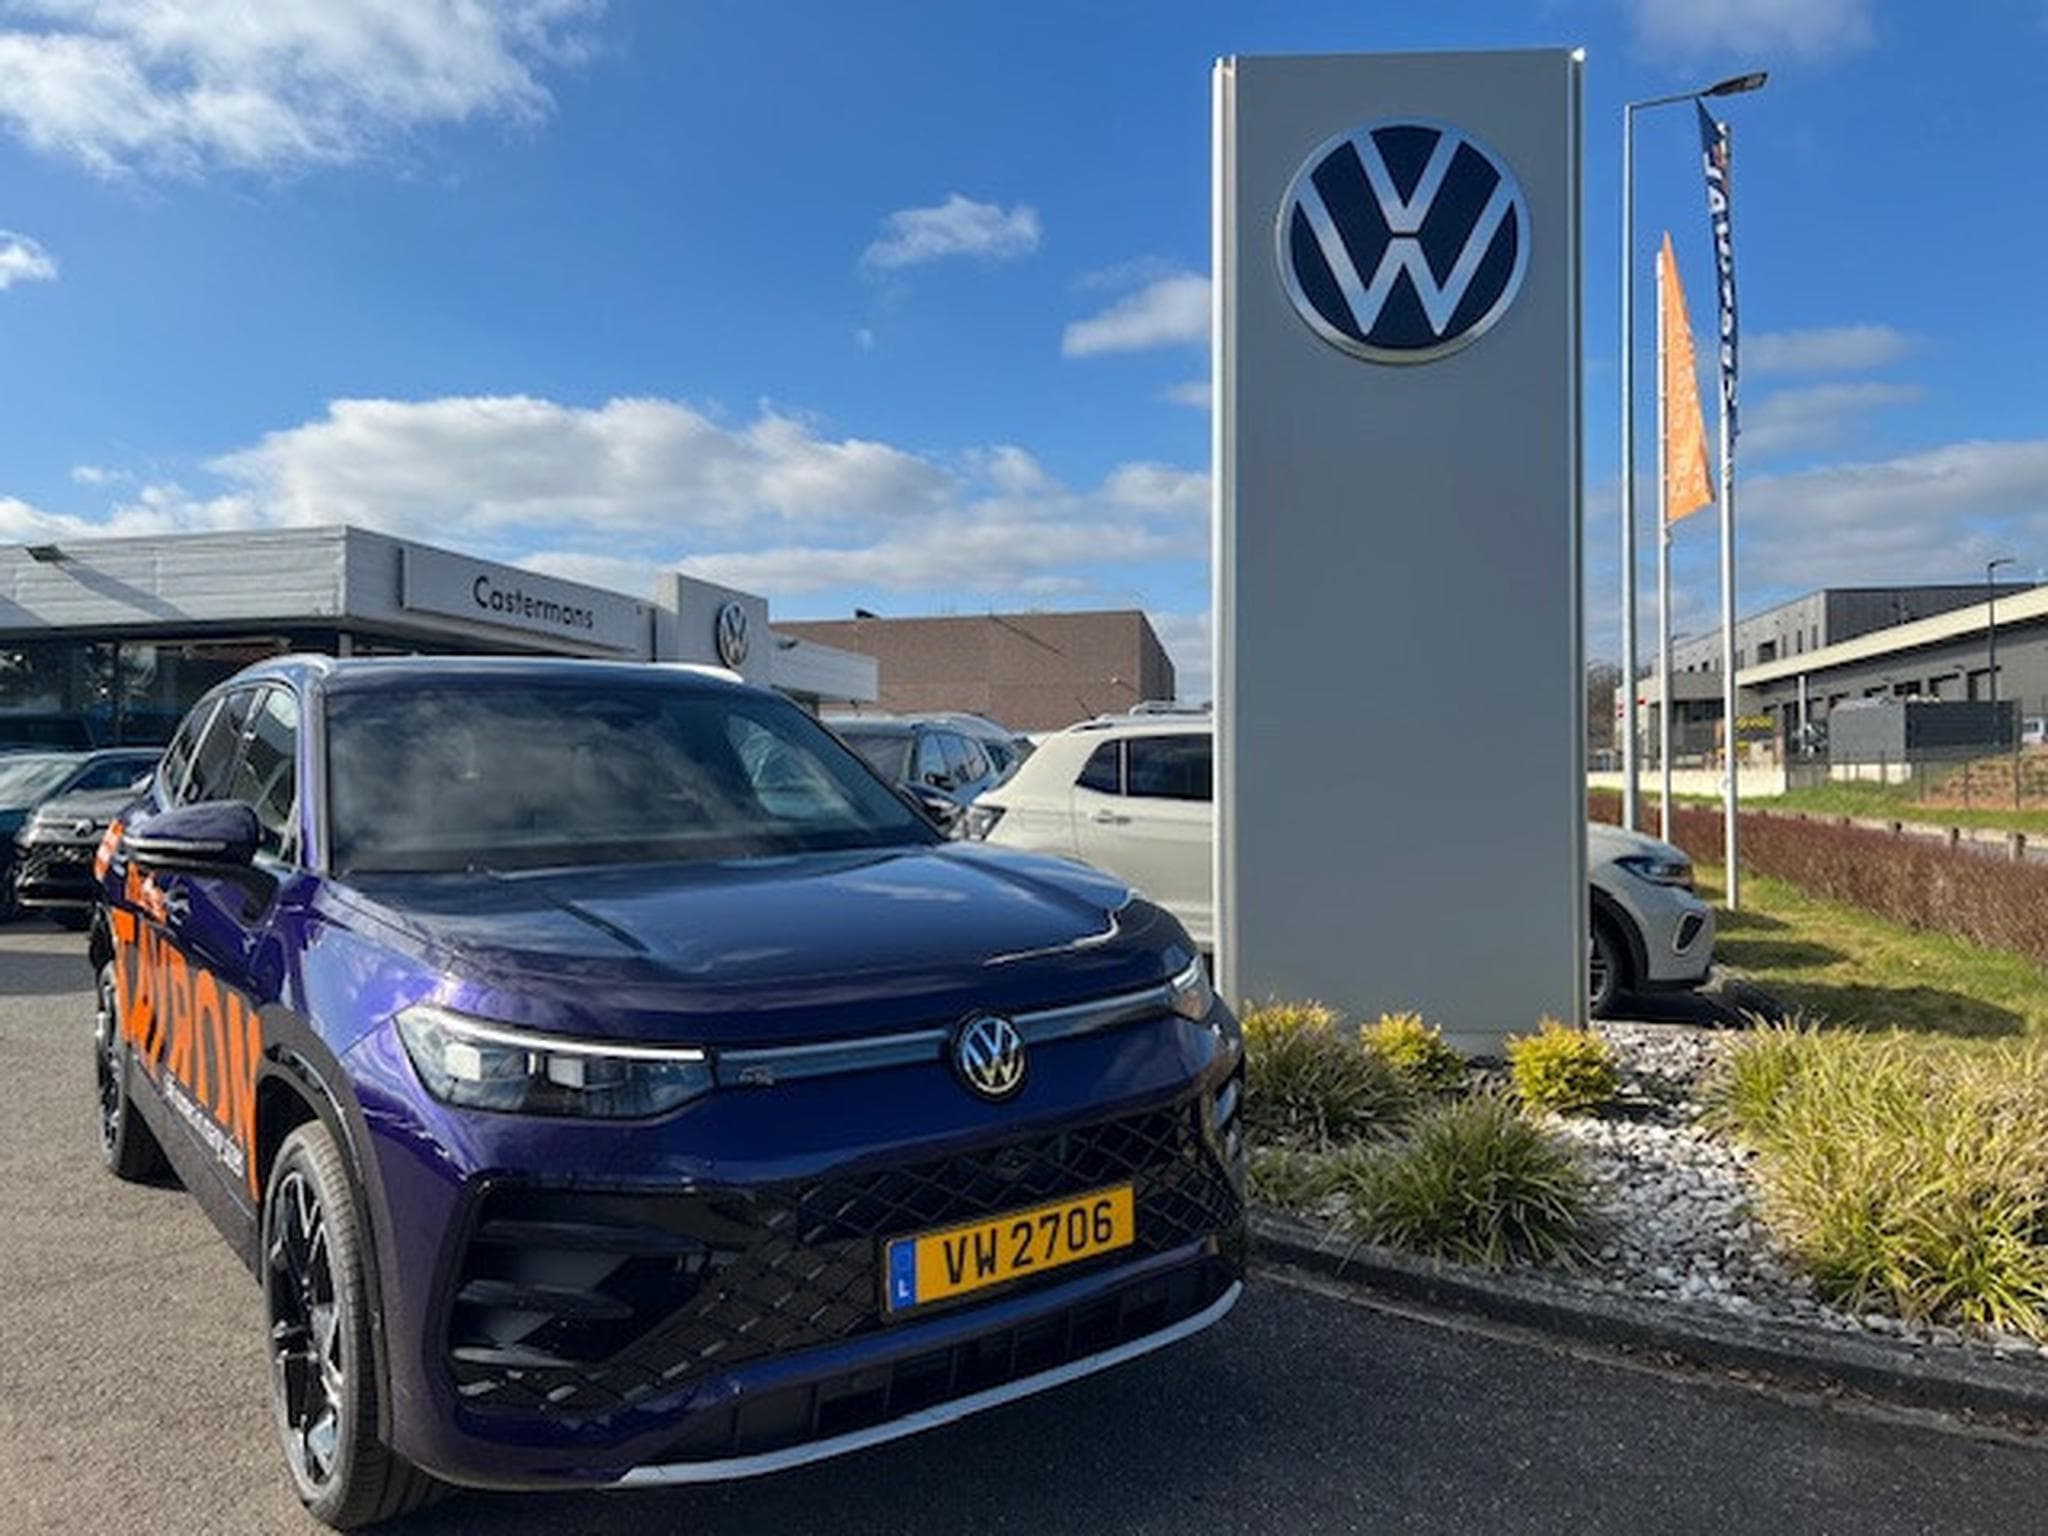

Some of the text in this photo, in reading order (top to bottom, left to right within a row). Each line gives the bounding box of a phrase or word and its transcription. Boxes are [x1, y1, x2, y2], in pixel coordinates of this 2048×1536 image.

[1280, 120, 1528, 360] VW
[472, 575, 595, 631] Castermans
[943, 1199, 1113, 1286] VW 2706
